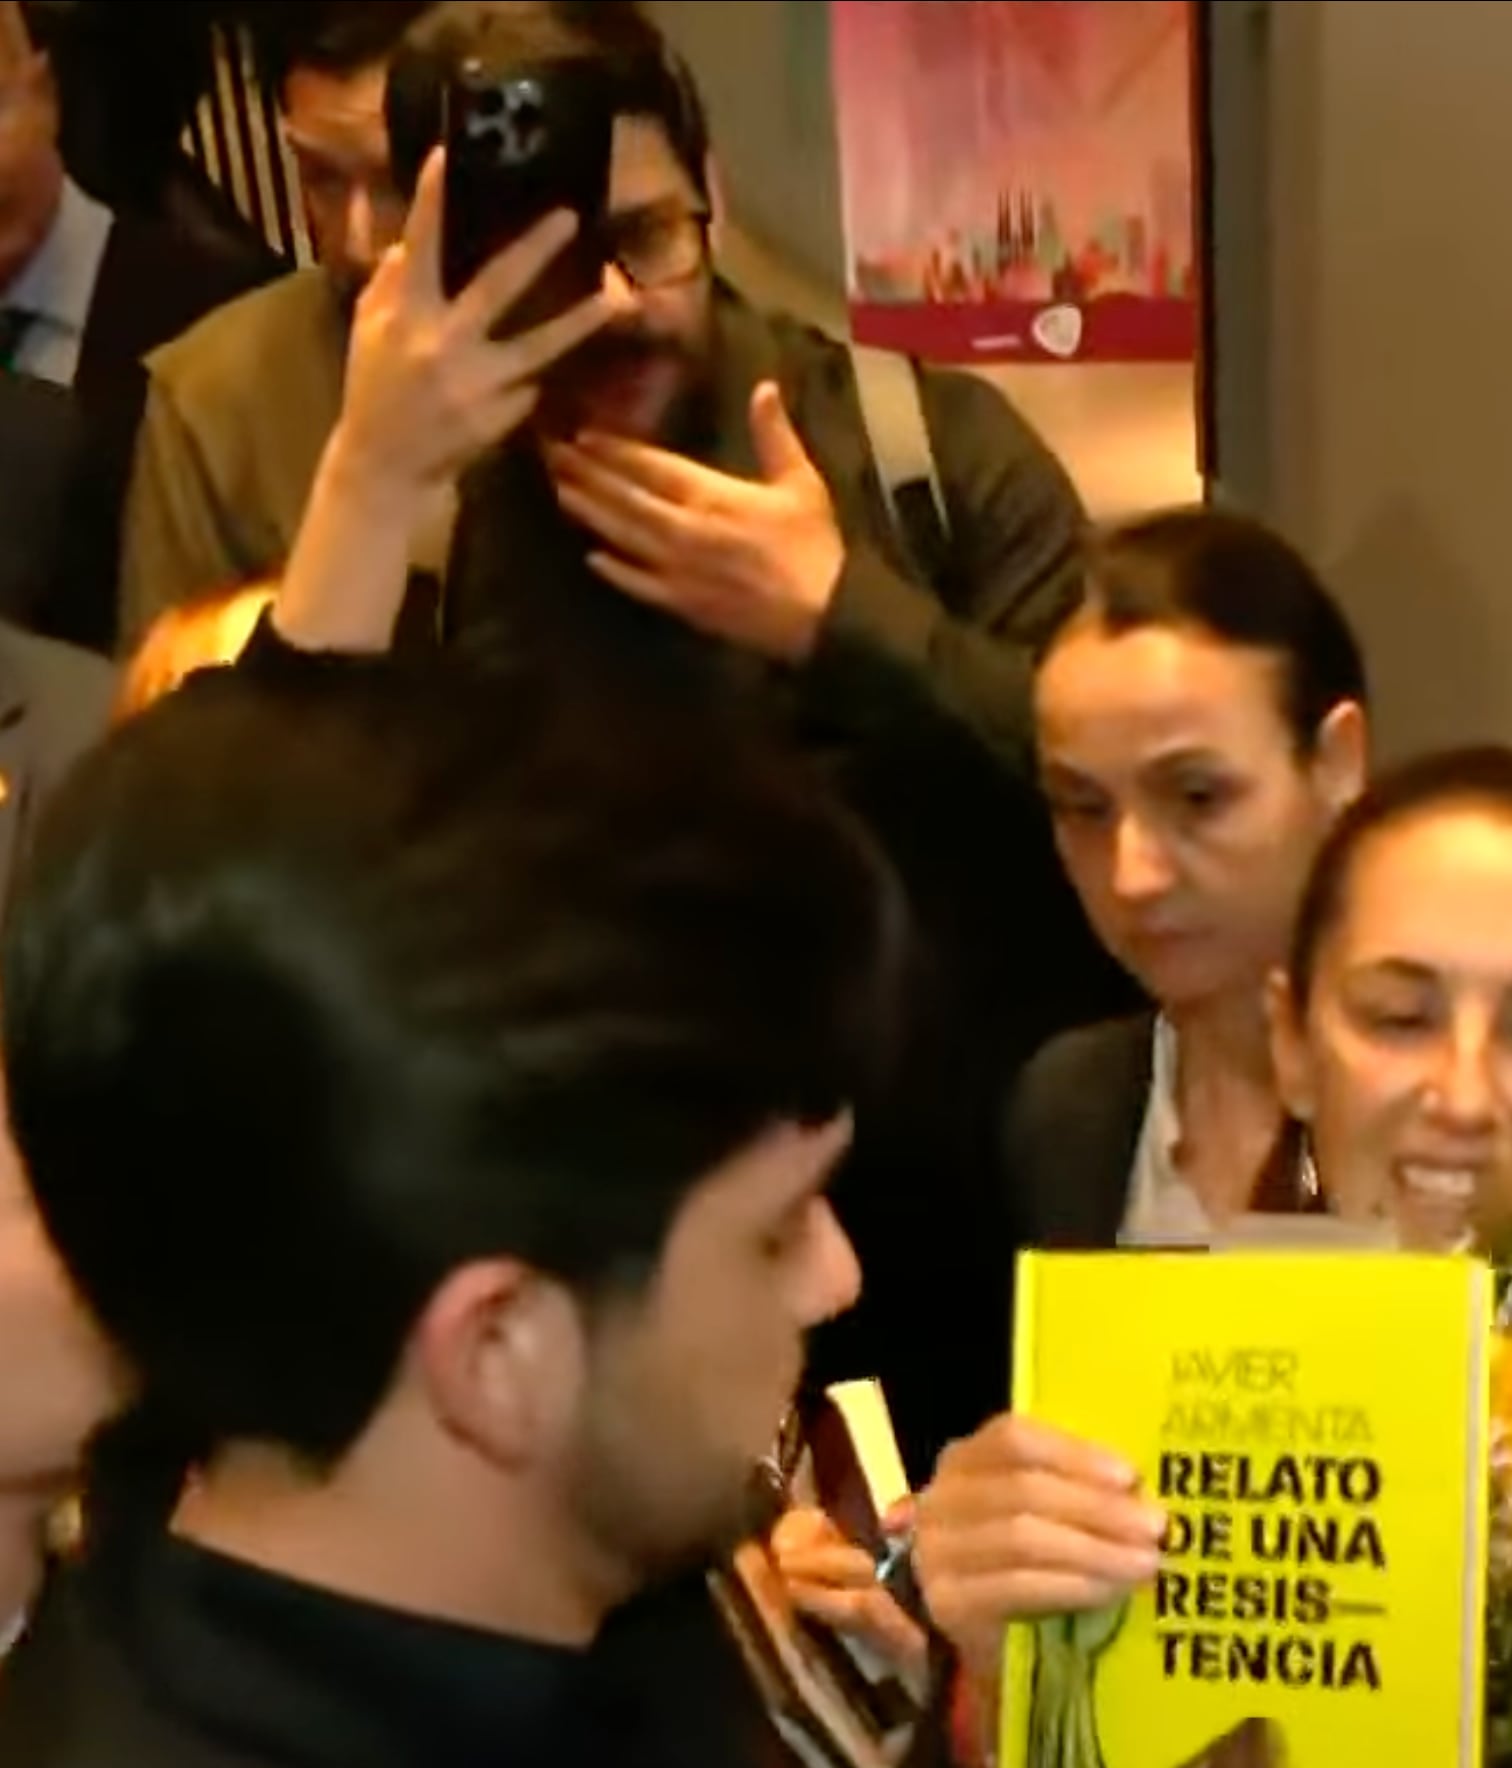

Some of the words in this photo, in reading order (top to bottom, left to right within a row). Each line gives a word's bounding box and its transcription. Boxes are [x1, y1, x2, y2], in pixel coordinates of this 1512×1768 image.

[1160, 1402, 1376, 1443] ARMENTA
[1158, 1451, 1381, 1504] RELATO
[1159, 1511, 1233, 1561] DE
[1250, 1516, 1386, 1570] UNA
[1156, 1630, 1382, 1692] TENCIA
